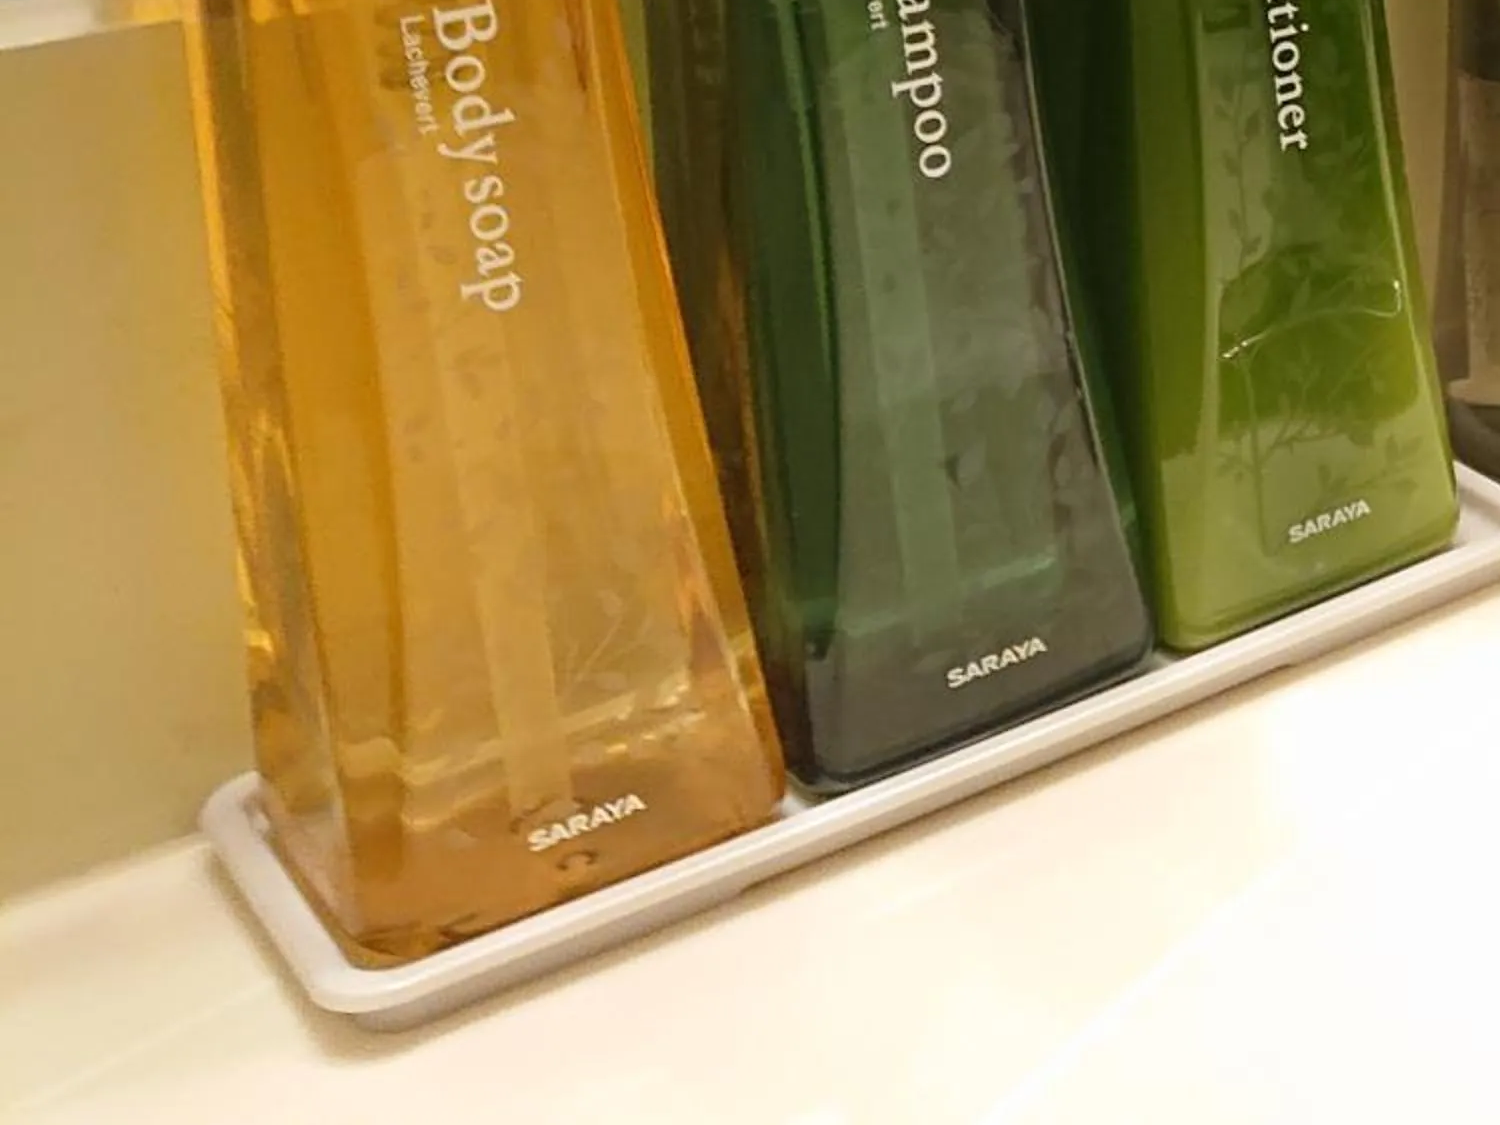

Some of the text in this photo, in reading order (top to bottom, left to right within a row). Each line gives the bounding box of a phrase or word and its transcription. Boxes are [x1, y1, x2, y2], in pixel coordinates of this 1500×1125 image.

[400, 15, 441, 136] Lachevert
[461, 174, 523, 312] soap
[1287, 498, 1371, 544] SARAYA
[946, 636, 1048, 688] SARAYA
[527, 793, 648, 852] SARAYA
